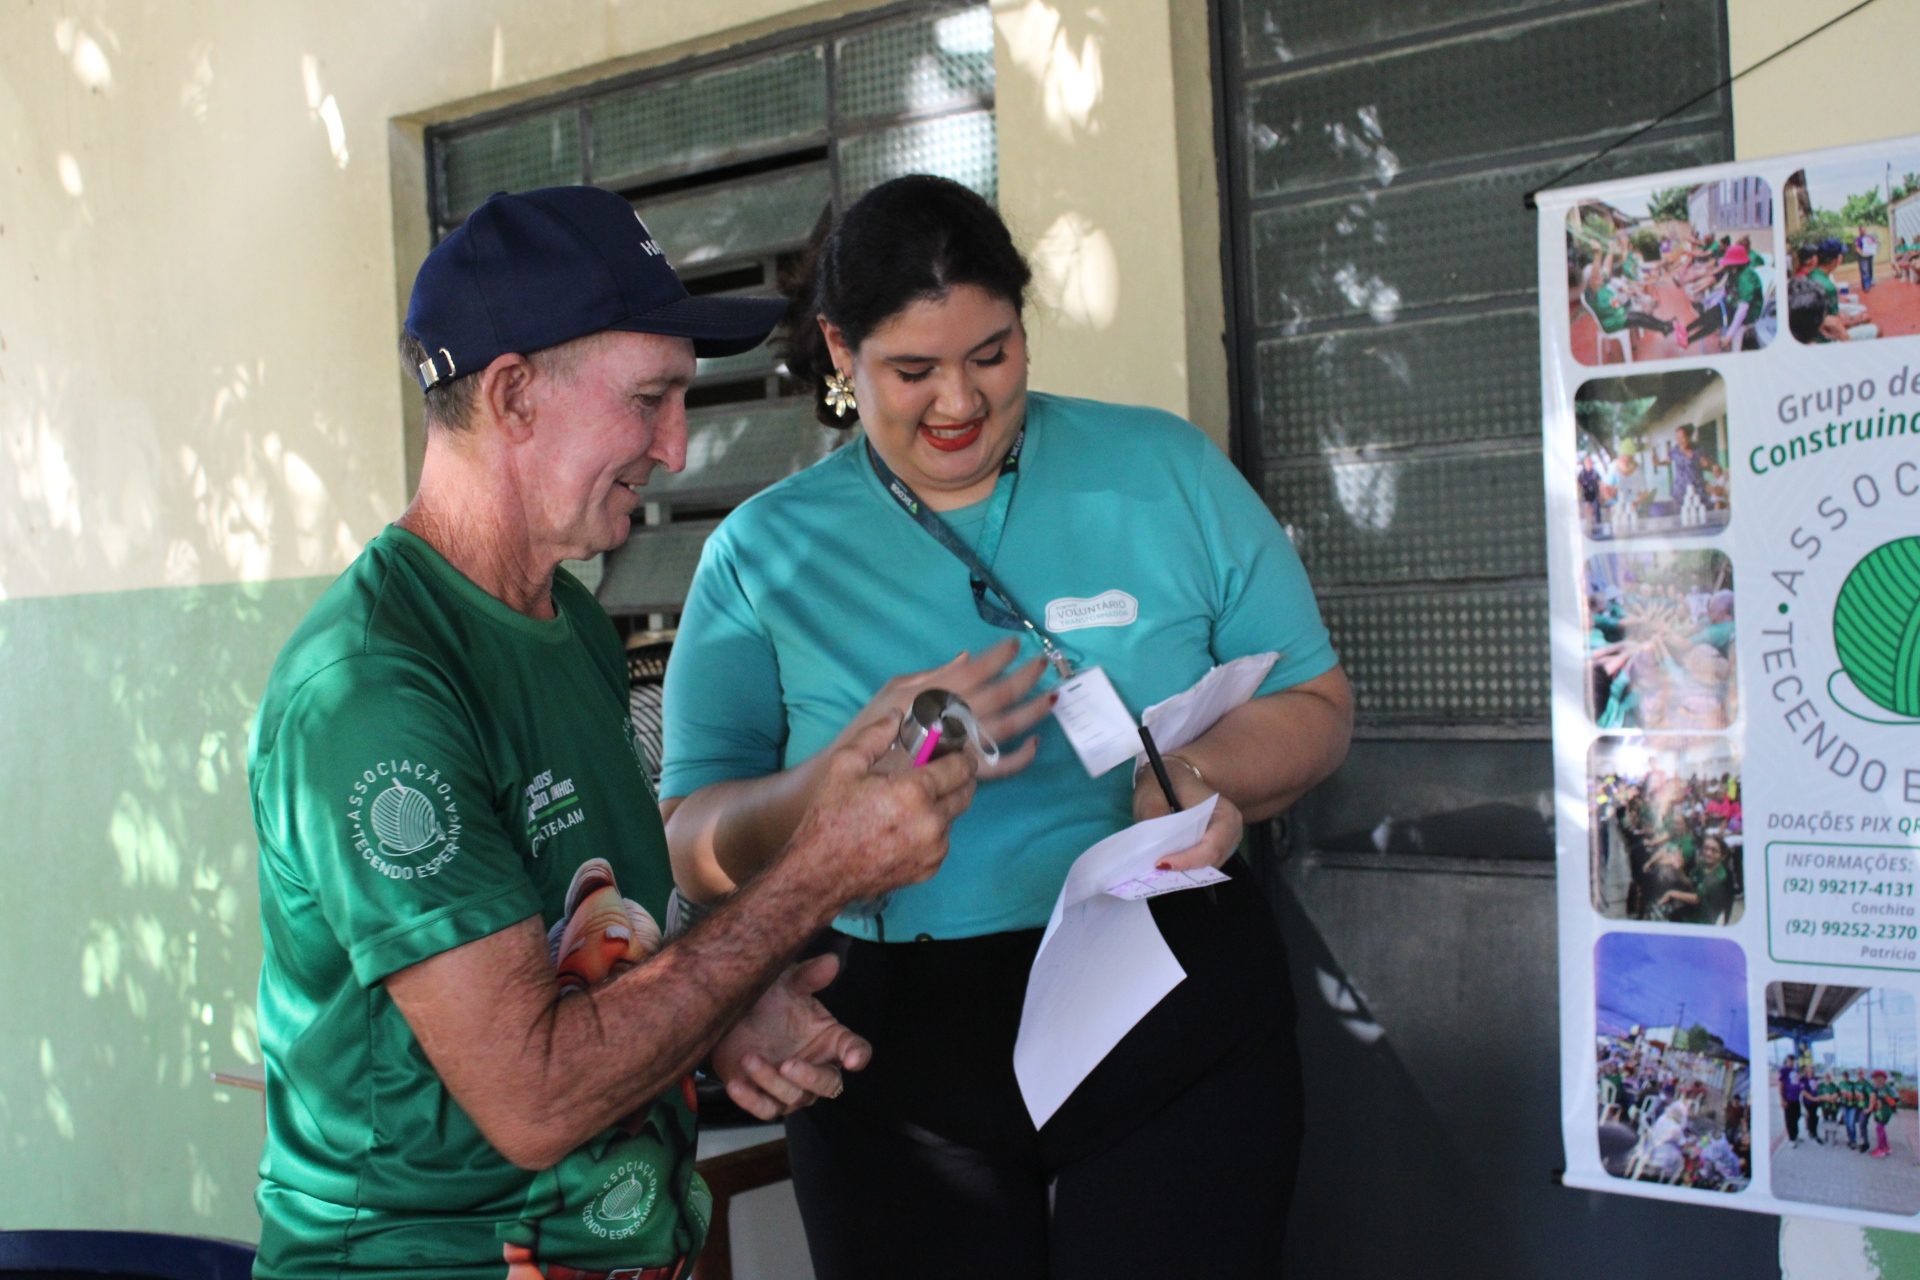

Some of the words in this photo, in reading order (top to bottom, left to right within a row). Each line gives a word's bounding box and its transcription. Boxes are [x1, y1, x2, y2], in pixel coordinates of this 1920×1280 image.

[1778, 379, 1876, 424] Grupo
[1771, 461, 1919, 597] ASSOC
[1762, 621, 1887, 793] TECENDO
[347, 760, 451, 821] ASSOCIAÇÃO
[1767, 811, 1855, 835] DOAÇÕES
[1861, 816, 1892, 833] PIX
[351, 829, 414, 880] TECENDO
[1785, 852, 1914, 875] INFORMAÇÕES:
[1783, 878, 1815, 895] (92)
[1819, 879, 1914, 897] 99217-4131
[1851, 901, 1915, 917] Conchita
[1785, 919, 1817, 937] (92)
[1821, 921, 1918, 940] 99252-2370
